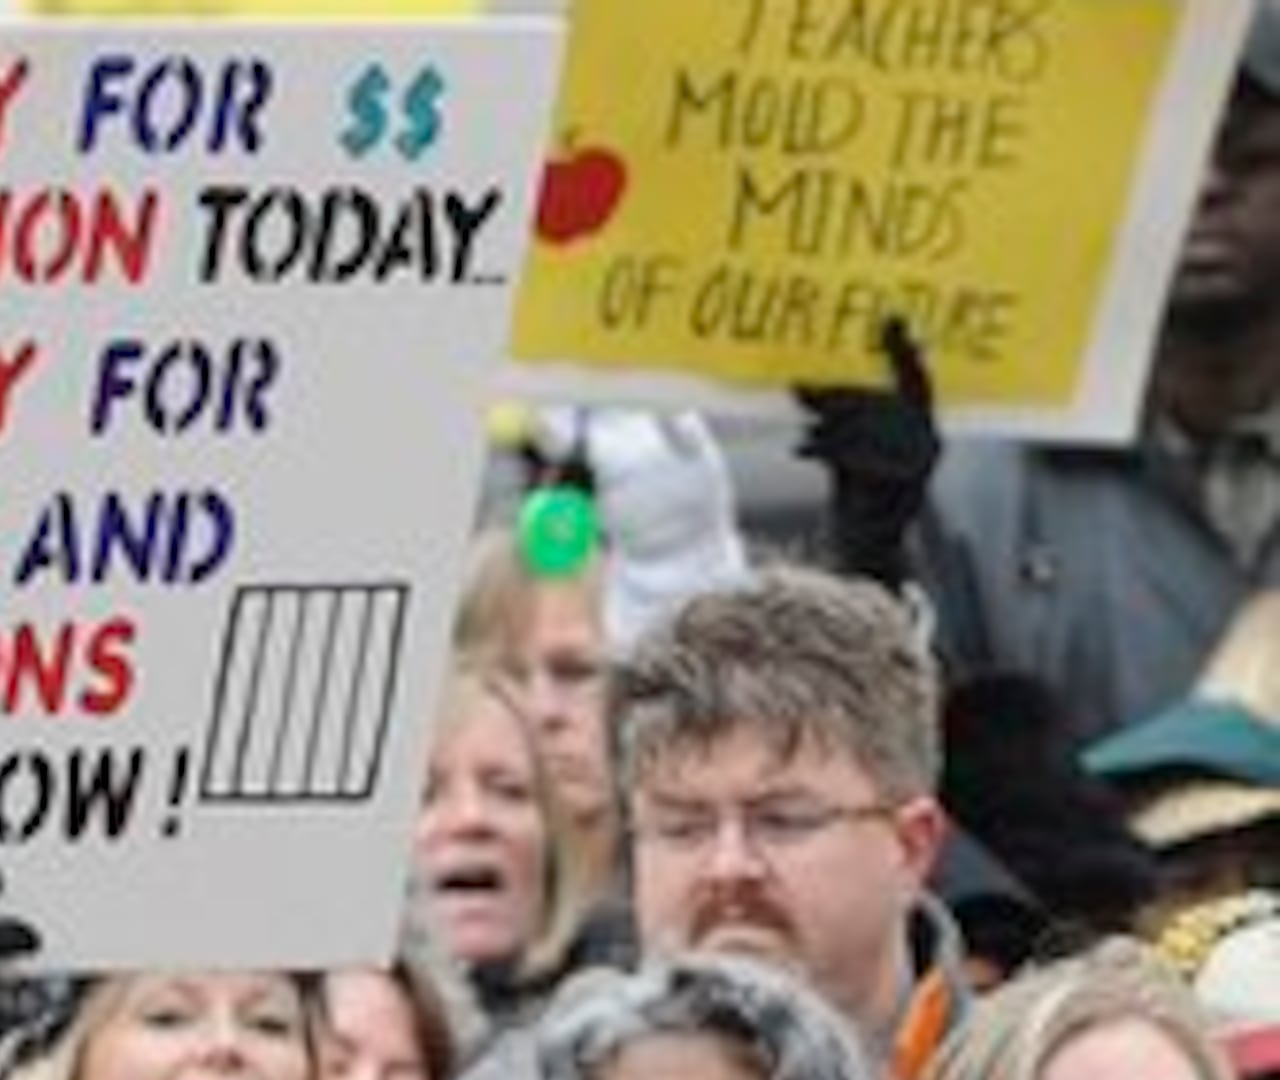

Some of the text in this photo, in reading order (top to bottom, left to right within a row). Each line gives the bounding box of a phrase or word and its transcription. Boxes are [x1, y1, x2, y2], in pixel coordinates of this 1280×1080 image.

[75, 54, 276, 156] FOR
[664, 70, 1032, 171] MOLD THE
[725, 165, 970, 262] MINDS
[598, 256, 684, 333] OF
[688, 259, 820, 347] OUR
[88, 336, 282, 439] FOR
[11, 489, 238, 586] AND
